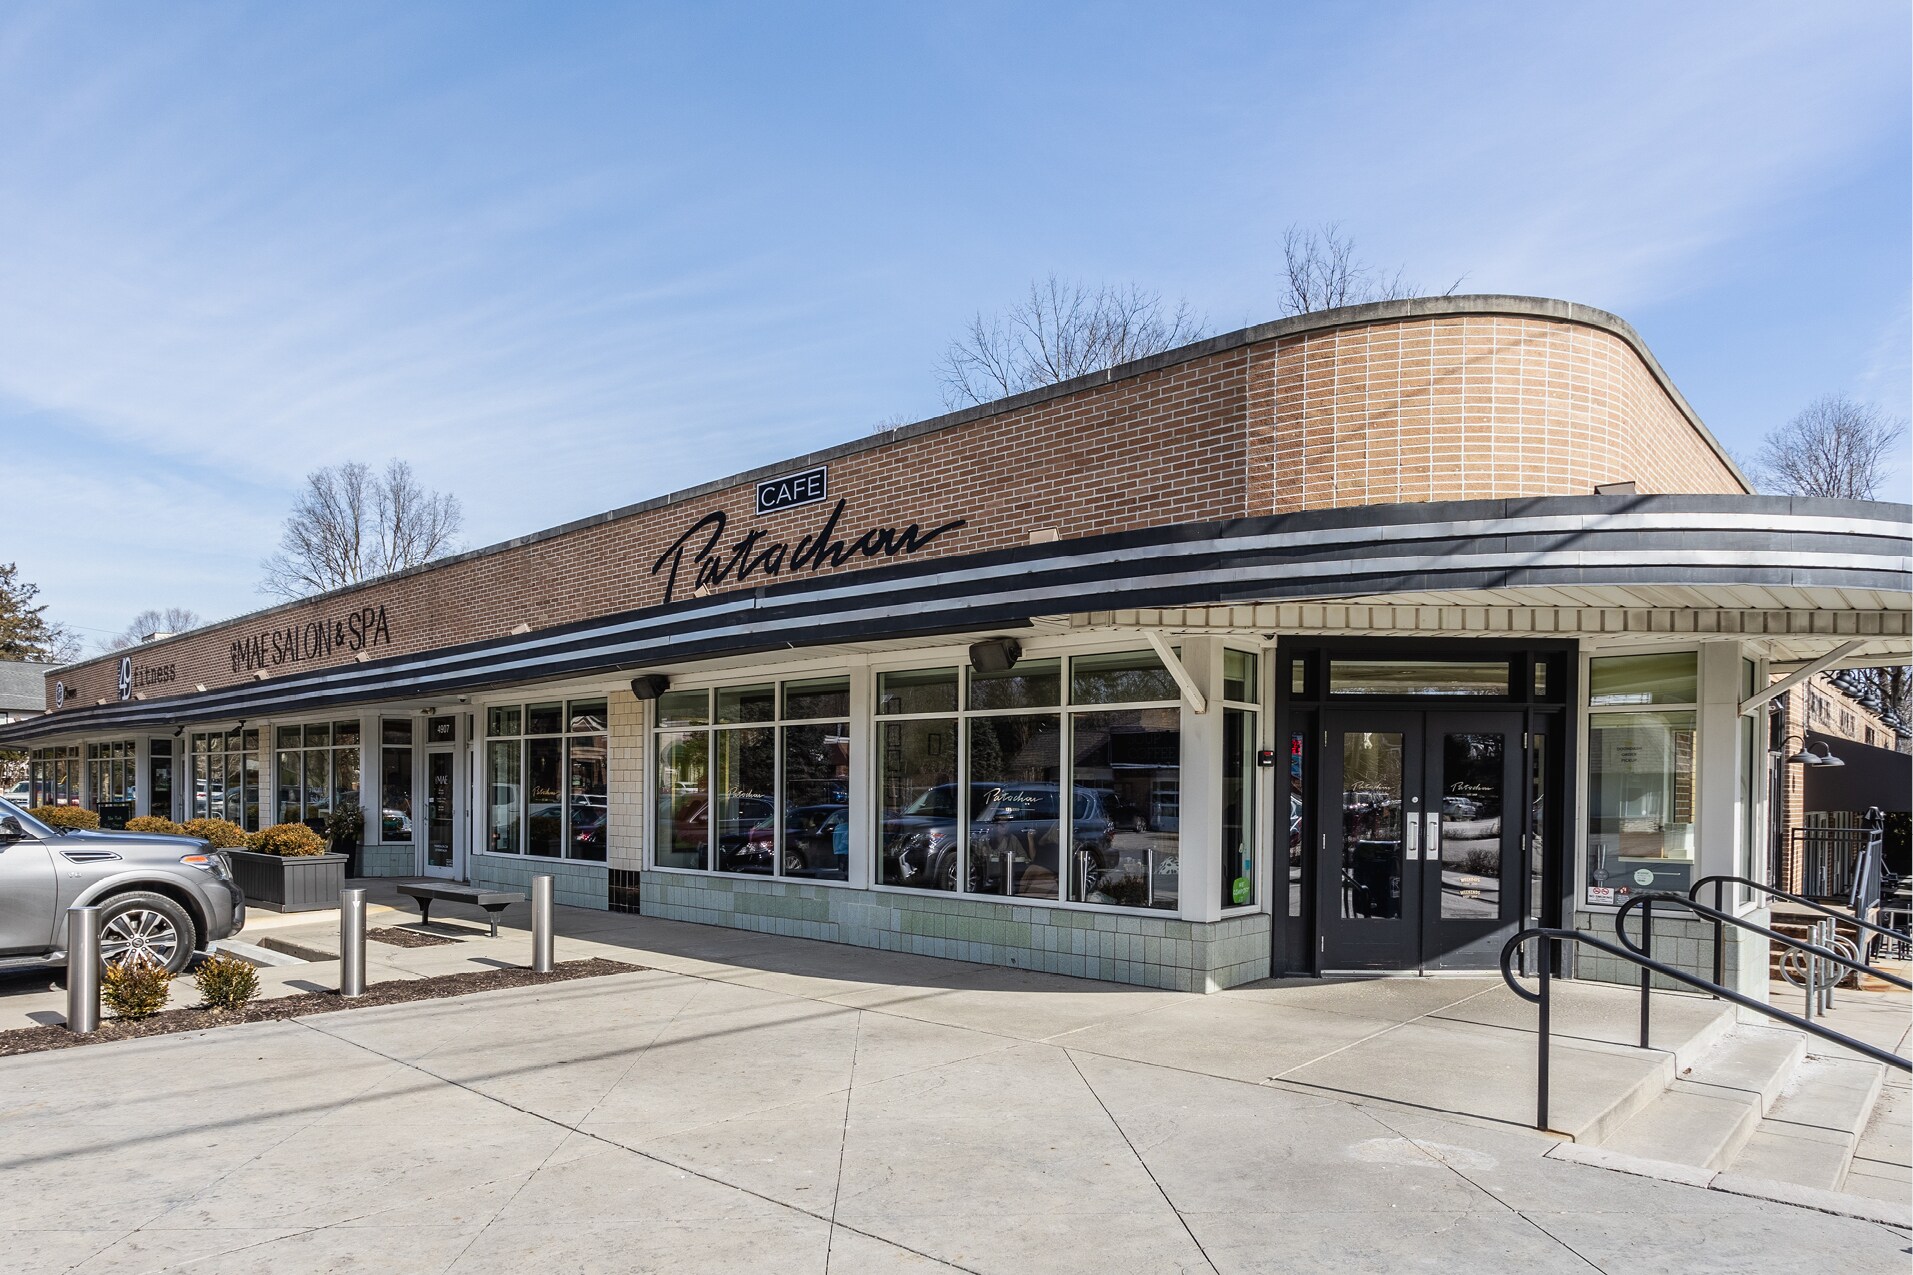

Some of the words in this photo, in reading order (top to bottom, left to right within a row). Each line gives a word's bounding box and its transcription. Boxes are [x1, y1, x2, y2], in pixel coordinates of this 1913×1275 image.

[761, 474, 821, 507] CAFE
[651, 498, 966, 604] Patachou
[237, 633, 270, 673] MAE
[272, 619, 332, 665] SALON
[335, 622, 344, 647] &
[348, 605, 391, 651] SPA
[118, 656, 132, 701] 49
[133, 664, 177, 688] fitness
[437, 724, 450, 734] 4907
[983, 787, 1044, 805] Patachou
